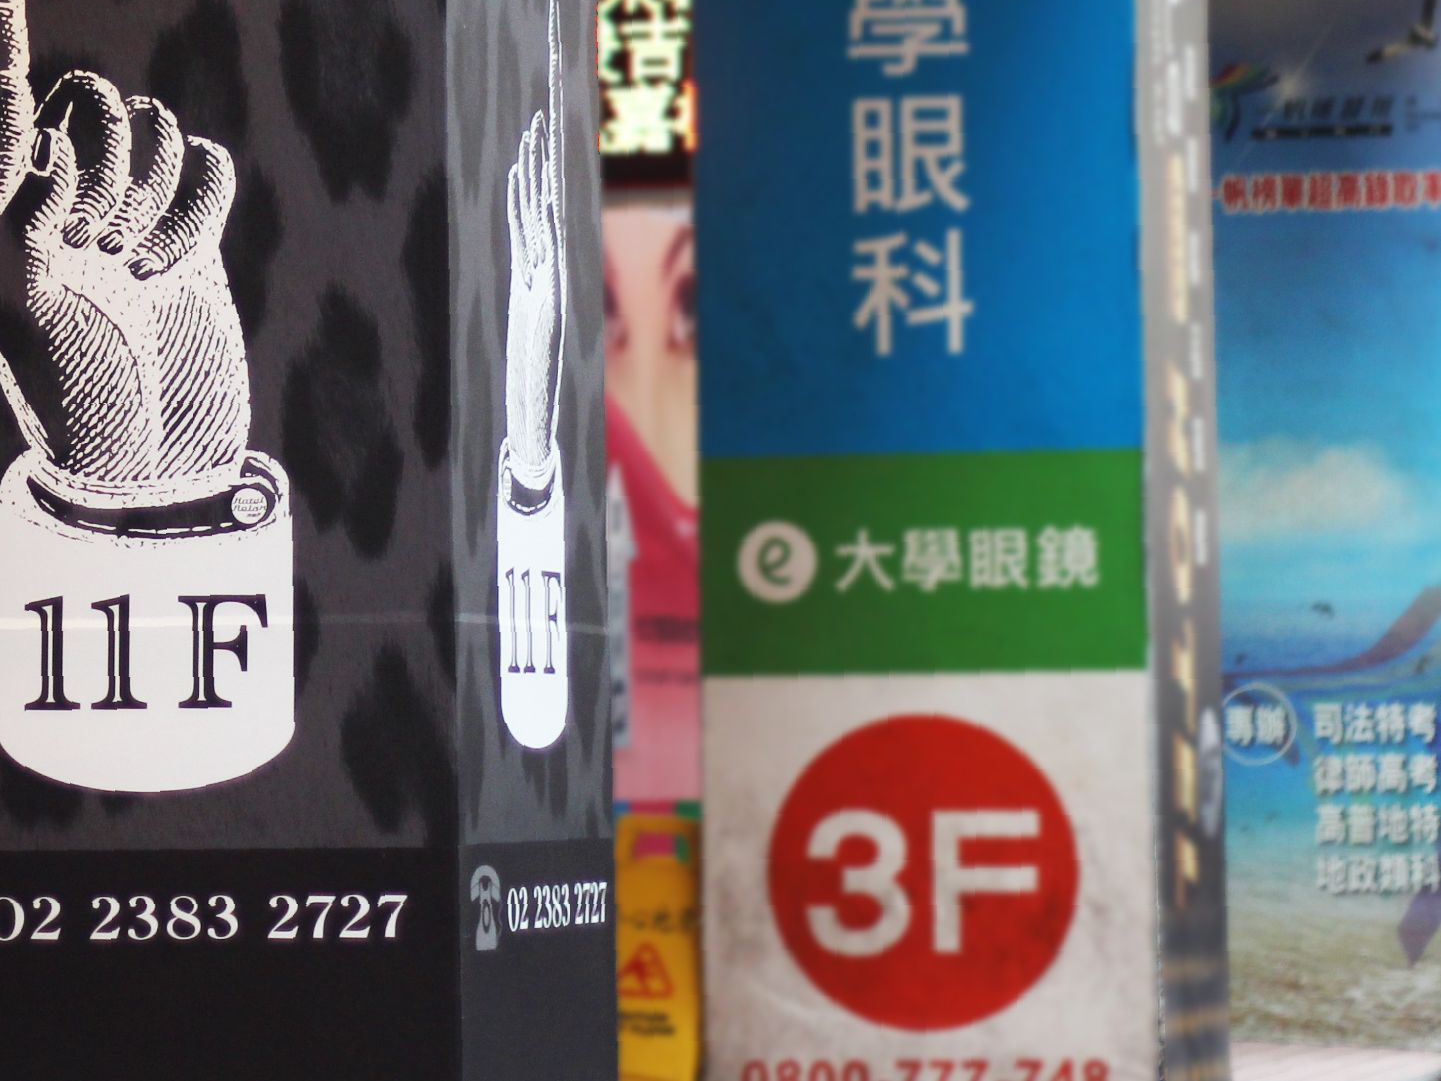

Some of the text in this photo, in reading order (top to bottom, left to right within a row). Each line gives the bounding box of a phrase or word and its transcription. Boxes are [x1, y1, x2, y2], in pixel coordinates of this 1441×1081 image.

[835, 526, 1100, 592] 大學眼鏡
[507, 886, 529, 932] 02
[533, 883, 571, 929] 2383
[574, 881, 608, 925] 2727
[804, 807, 1040, 958] 3F
[89, 894, 239, 941] 2383
[267, 893, 409, 940] 2727
